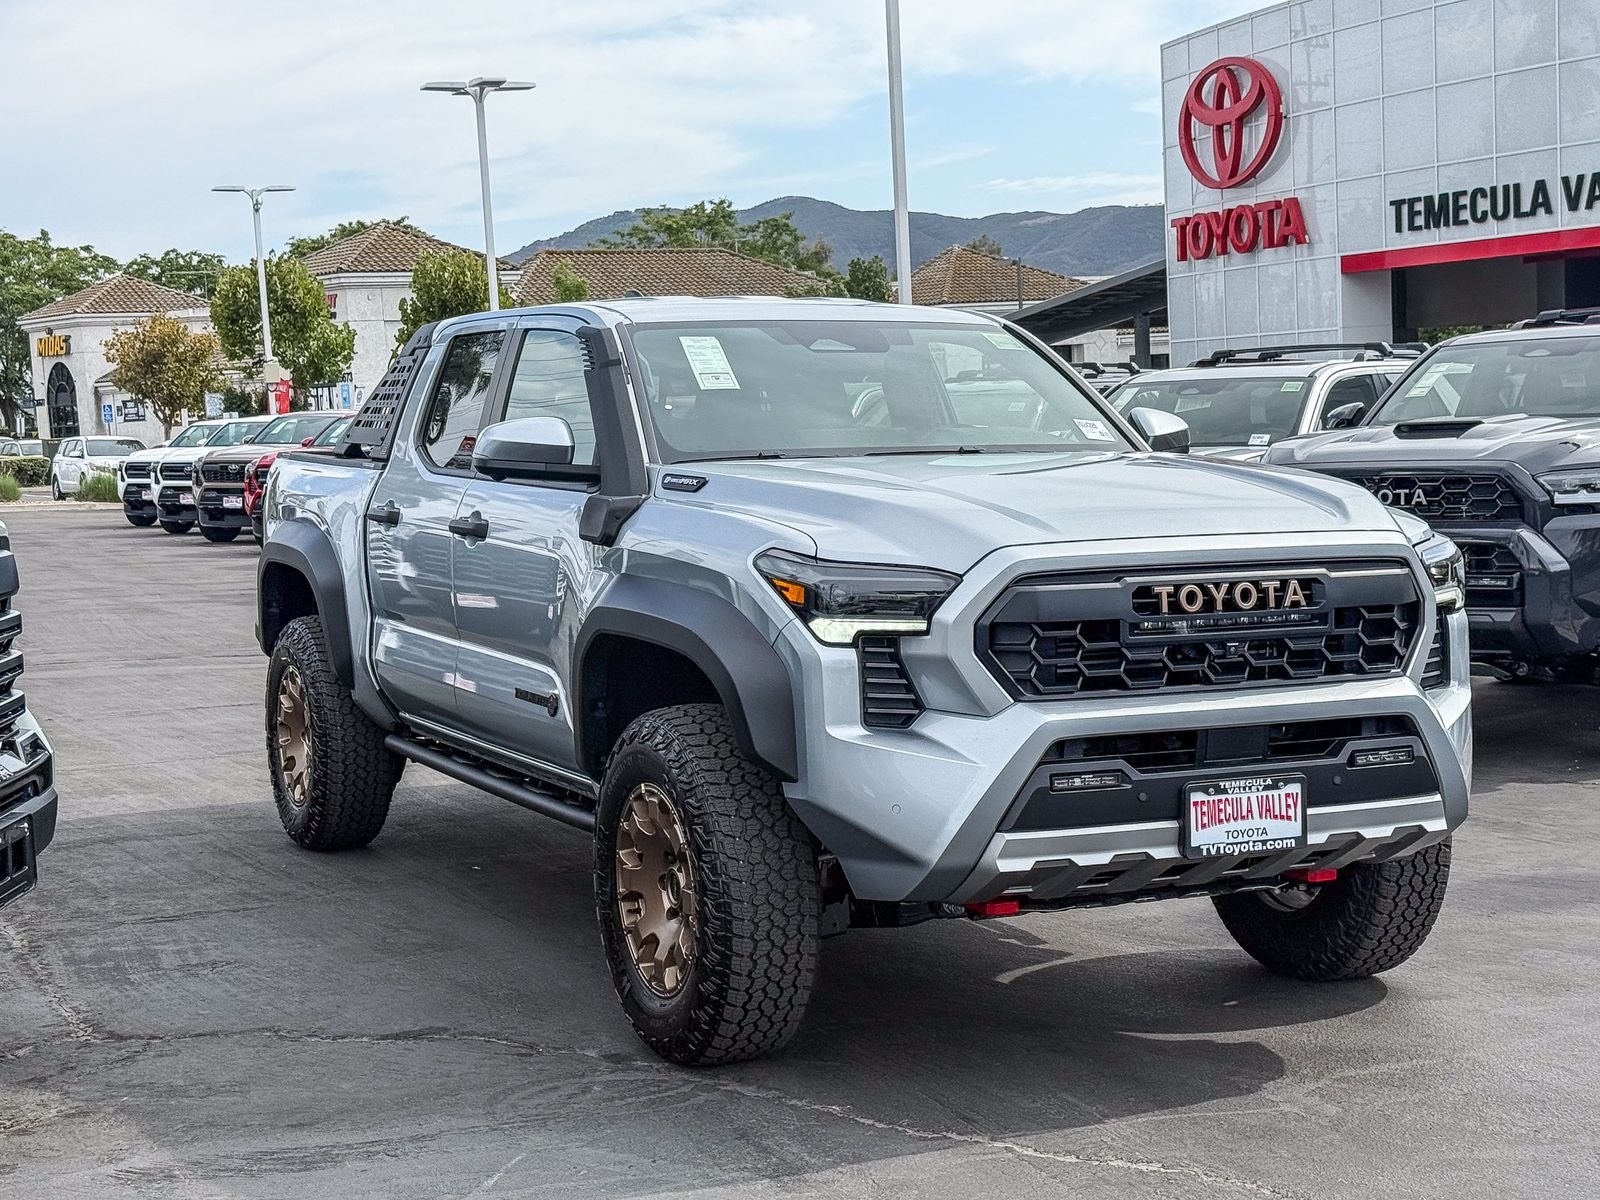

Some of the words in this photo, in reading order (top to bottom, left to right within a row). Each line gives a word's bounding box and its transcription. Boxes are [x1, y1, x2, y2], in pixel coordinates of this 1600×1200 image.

[1390, 179, 1552, 233] TEMECULA
[1171, 197, 1310, 262] TOYOTA
[37, 335, 67, 357] MIDAS
[1374, 489, 1428, 505] OTA
[1152, 579, 1306, 615] TOYOTA
[1219, 778, 1272, 789] TEMECULA
[1227, 786, 1264, 794] VALLEY
[1192, 796, 1253, 832] TEMECULA
[1256, 792, 1299, 823] VALLEY
[1225, 827, 1268, 839] TOYOTA
[1200, 839, 1296, 856] TVToyota.com
